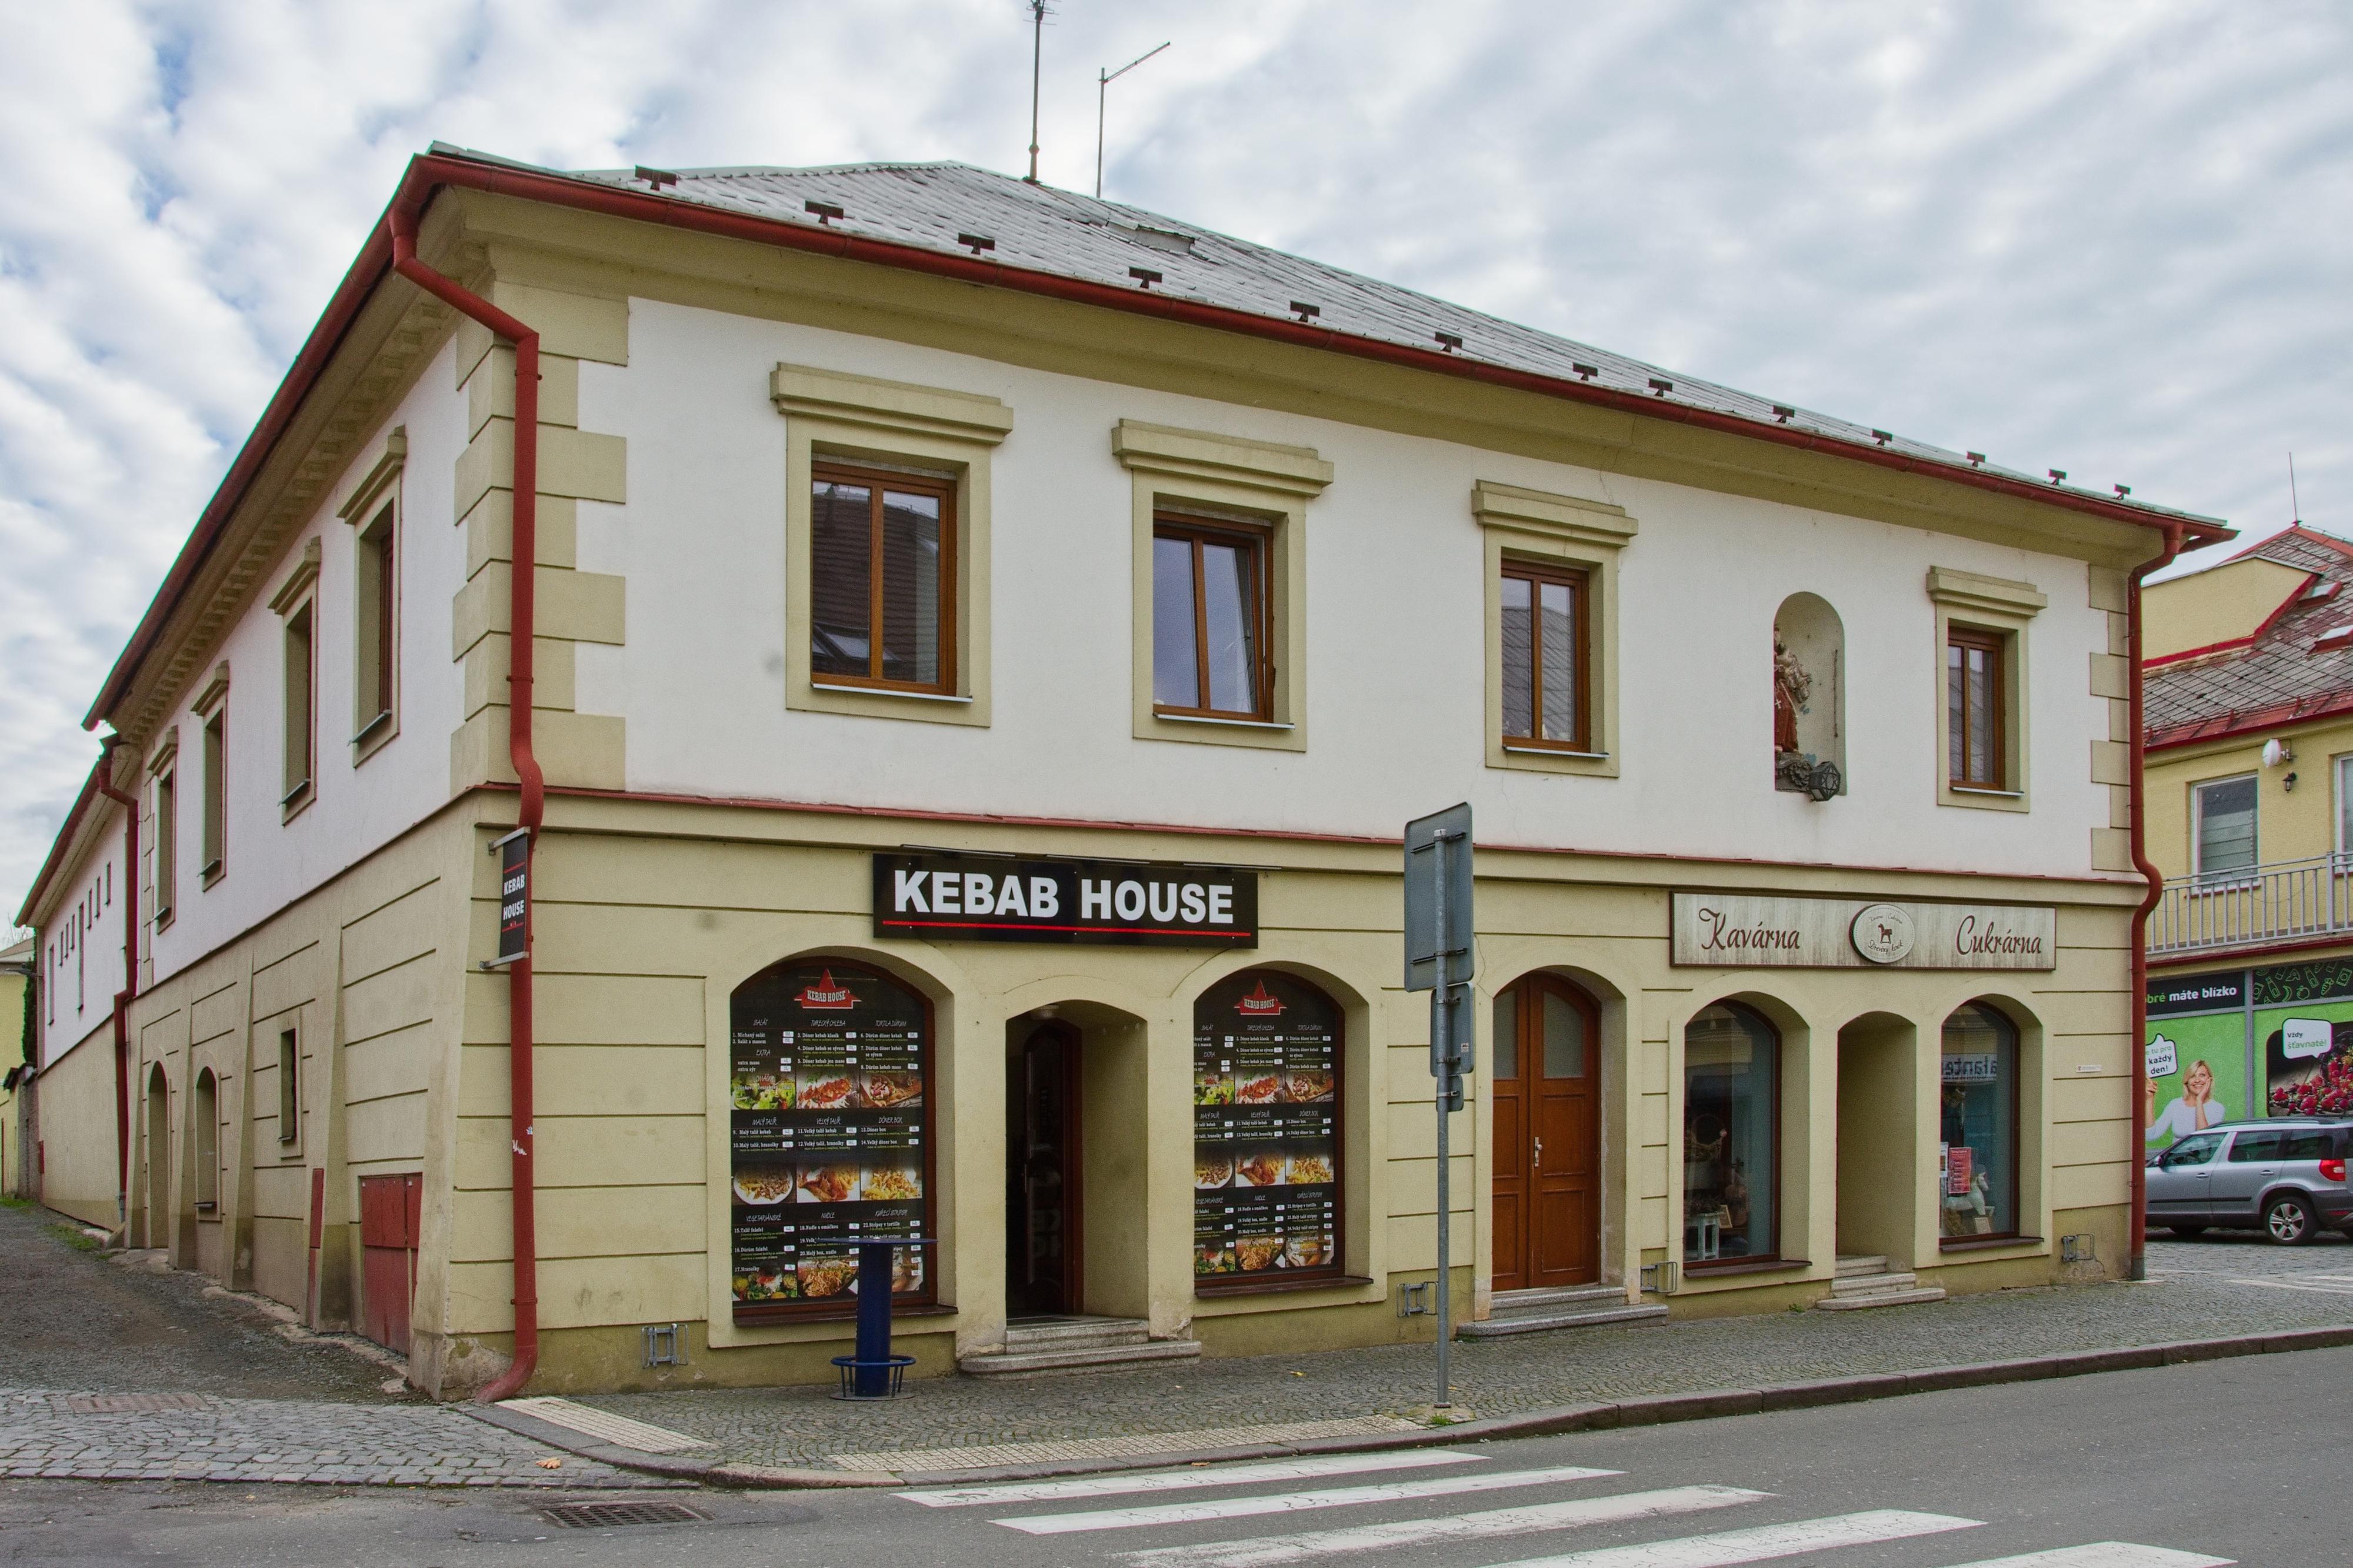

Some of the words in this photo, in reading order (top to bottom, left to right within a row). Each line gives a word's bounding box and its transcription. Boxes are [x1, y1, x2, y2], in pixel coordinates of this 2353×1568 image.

[504, 874, 525, 896] KEBAB
[895, 870, 1059, 918] KEBAB
[1081, 879, 1234, 924] HOUSE
[503, 900, 524, 920] HOUSE
[1698, 908, 1799, 950] Kavárna
[1956, 915, 2041, 955] Cukrárna
[807, 989, 827, 1002] KEBAB
[827, 990, 846, 1002] HOUSE
[1244, 998, 1259, 1009] KEBAB
[1260, 999, 1275, 1009] HOUSE
[2145, 992, 2166, 1004] bré
[2169, 990, 2199, 1002] máte
[2202, 986, 2237, 998] blízko
[2148, 1054, 2172, 1065] každý
[2151, 1066, 2168, 1075] den!
